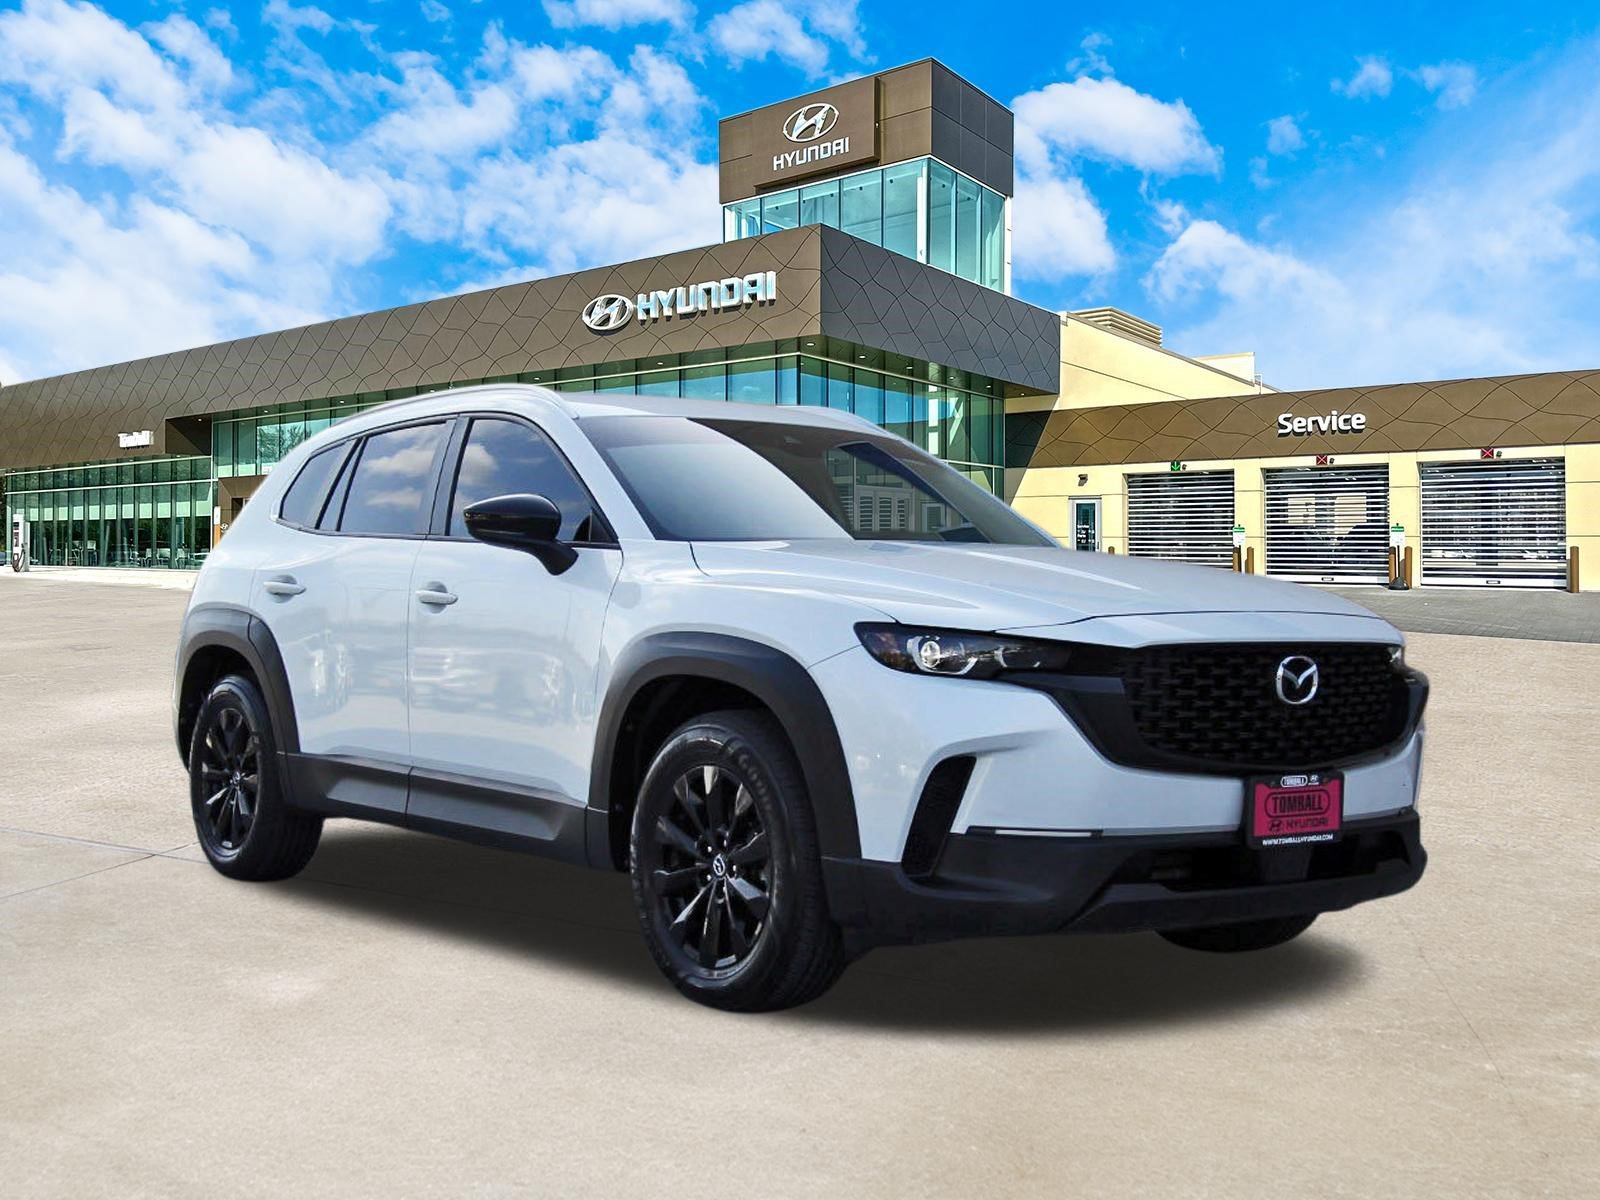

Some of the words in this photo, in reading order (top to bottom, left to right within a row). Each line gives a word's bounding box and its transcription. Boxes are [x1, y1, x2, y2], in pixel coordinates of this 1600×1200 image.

[773, 137, 849, 171] HYUNDAI
[637, 271, 777, 321] HYUNDAI
[1278, 410, 1366, 434] Service
[1272, 795, 1323, 814] TOMBALL
